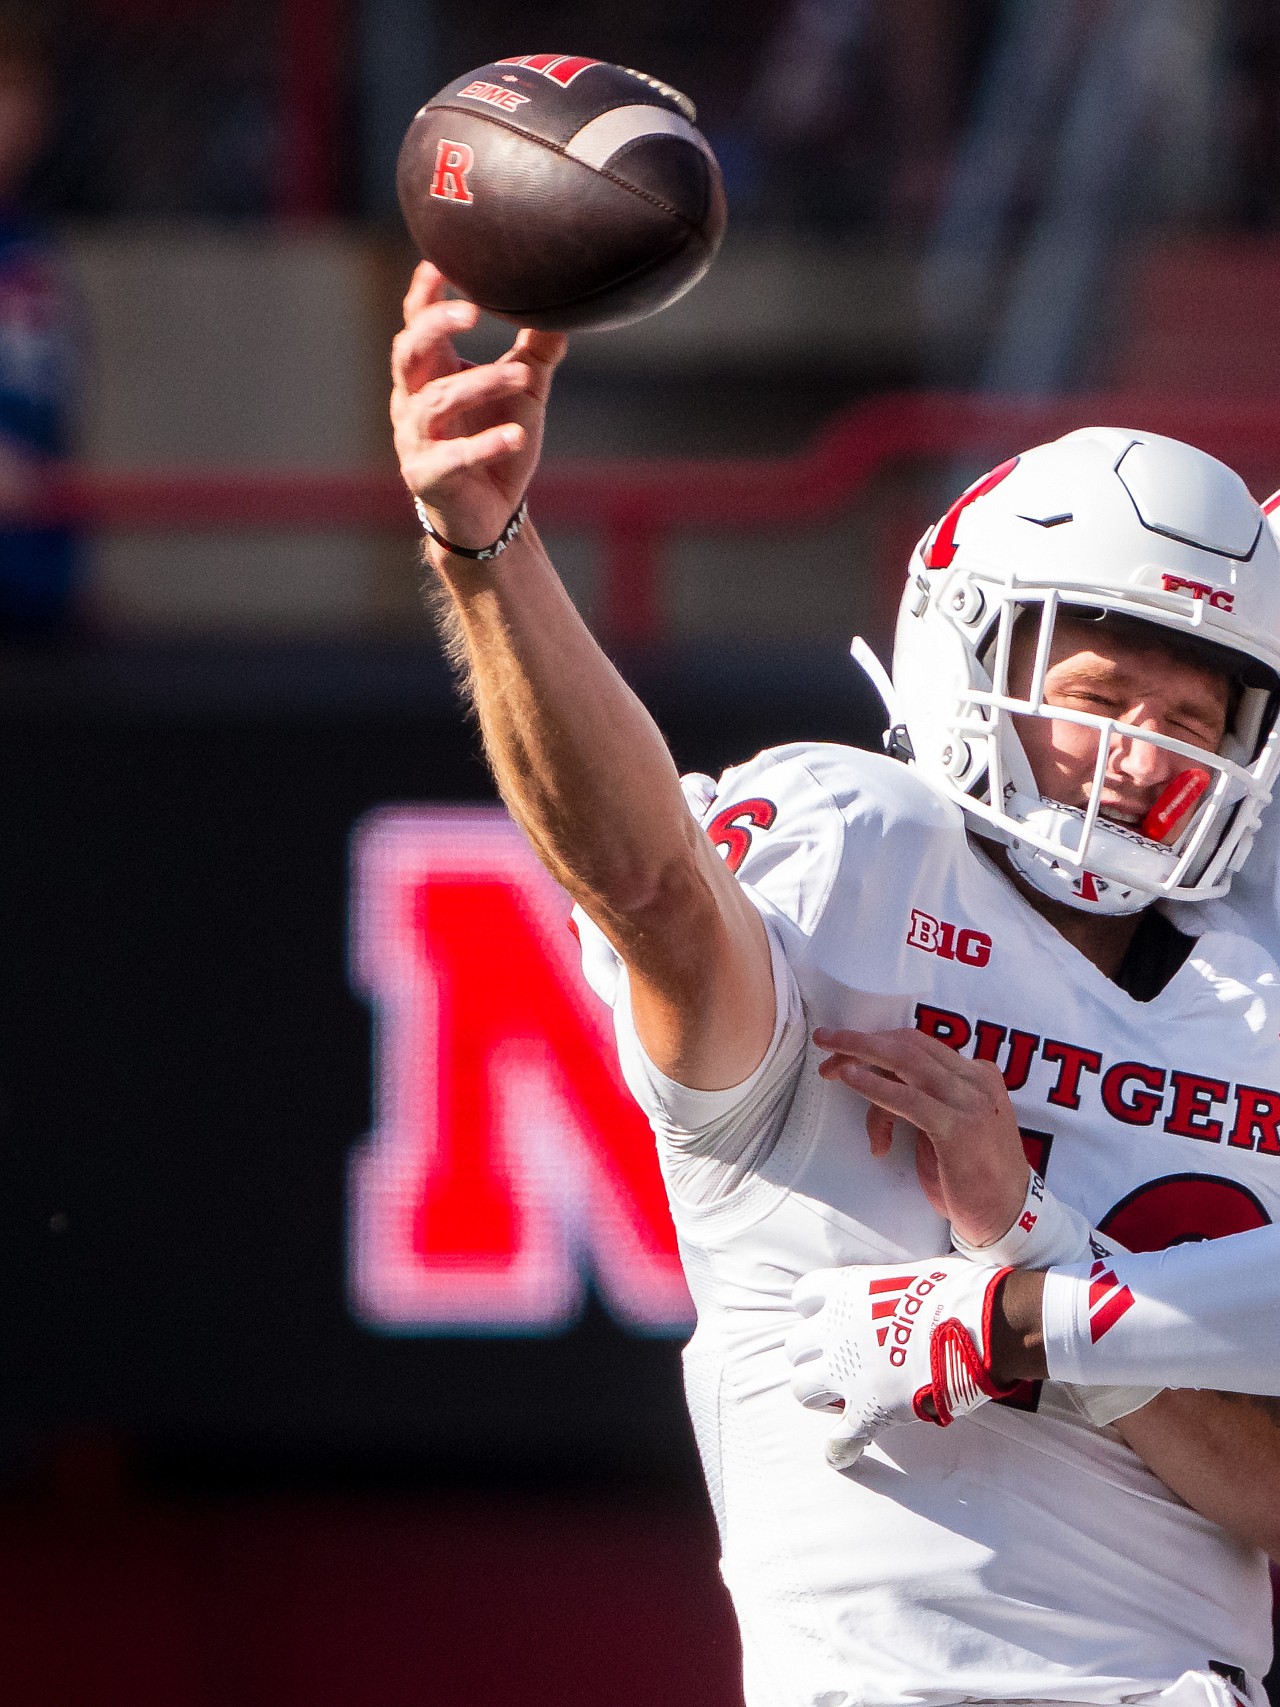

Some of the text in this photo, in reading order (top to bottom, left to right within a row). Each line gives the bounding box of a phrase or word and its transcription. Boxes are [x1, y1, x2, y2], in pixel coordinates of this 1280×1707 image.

[430, 138, 474, 204] R
[1018, 1210, 1038, 1233] R
[889, 1271, 948, 1368] adidas
